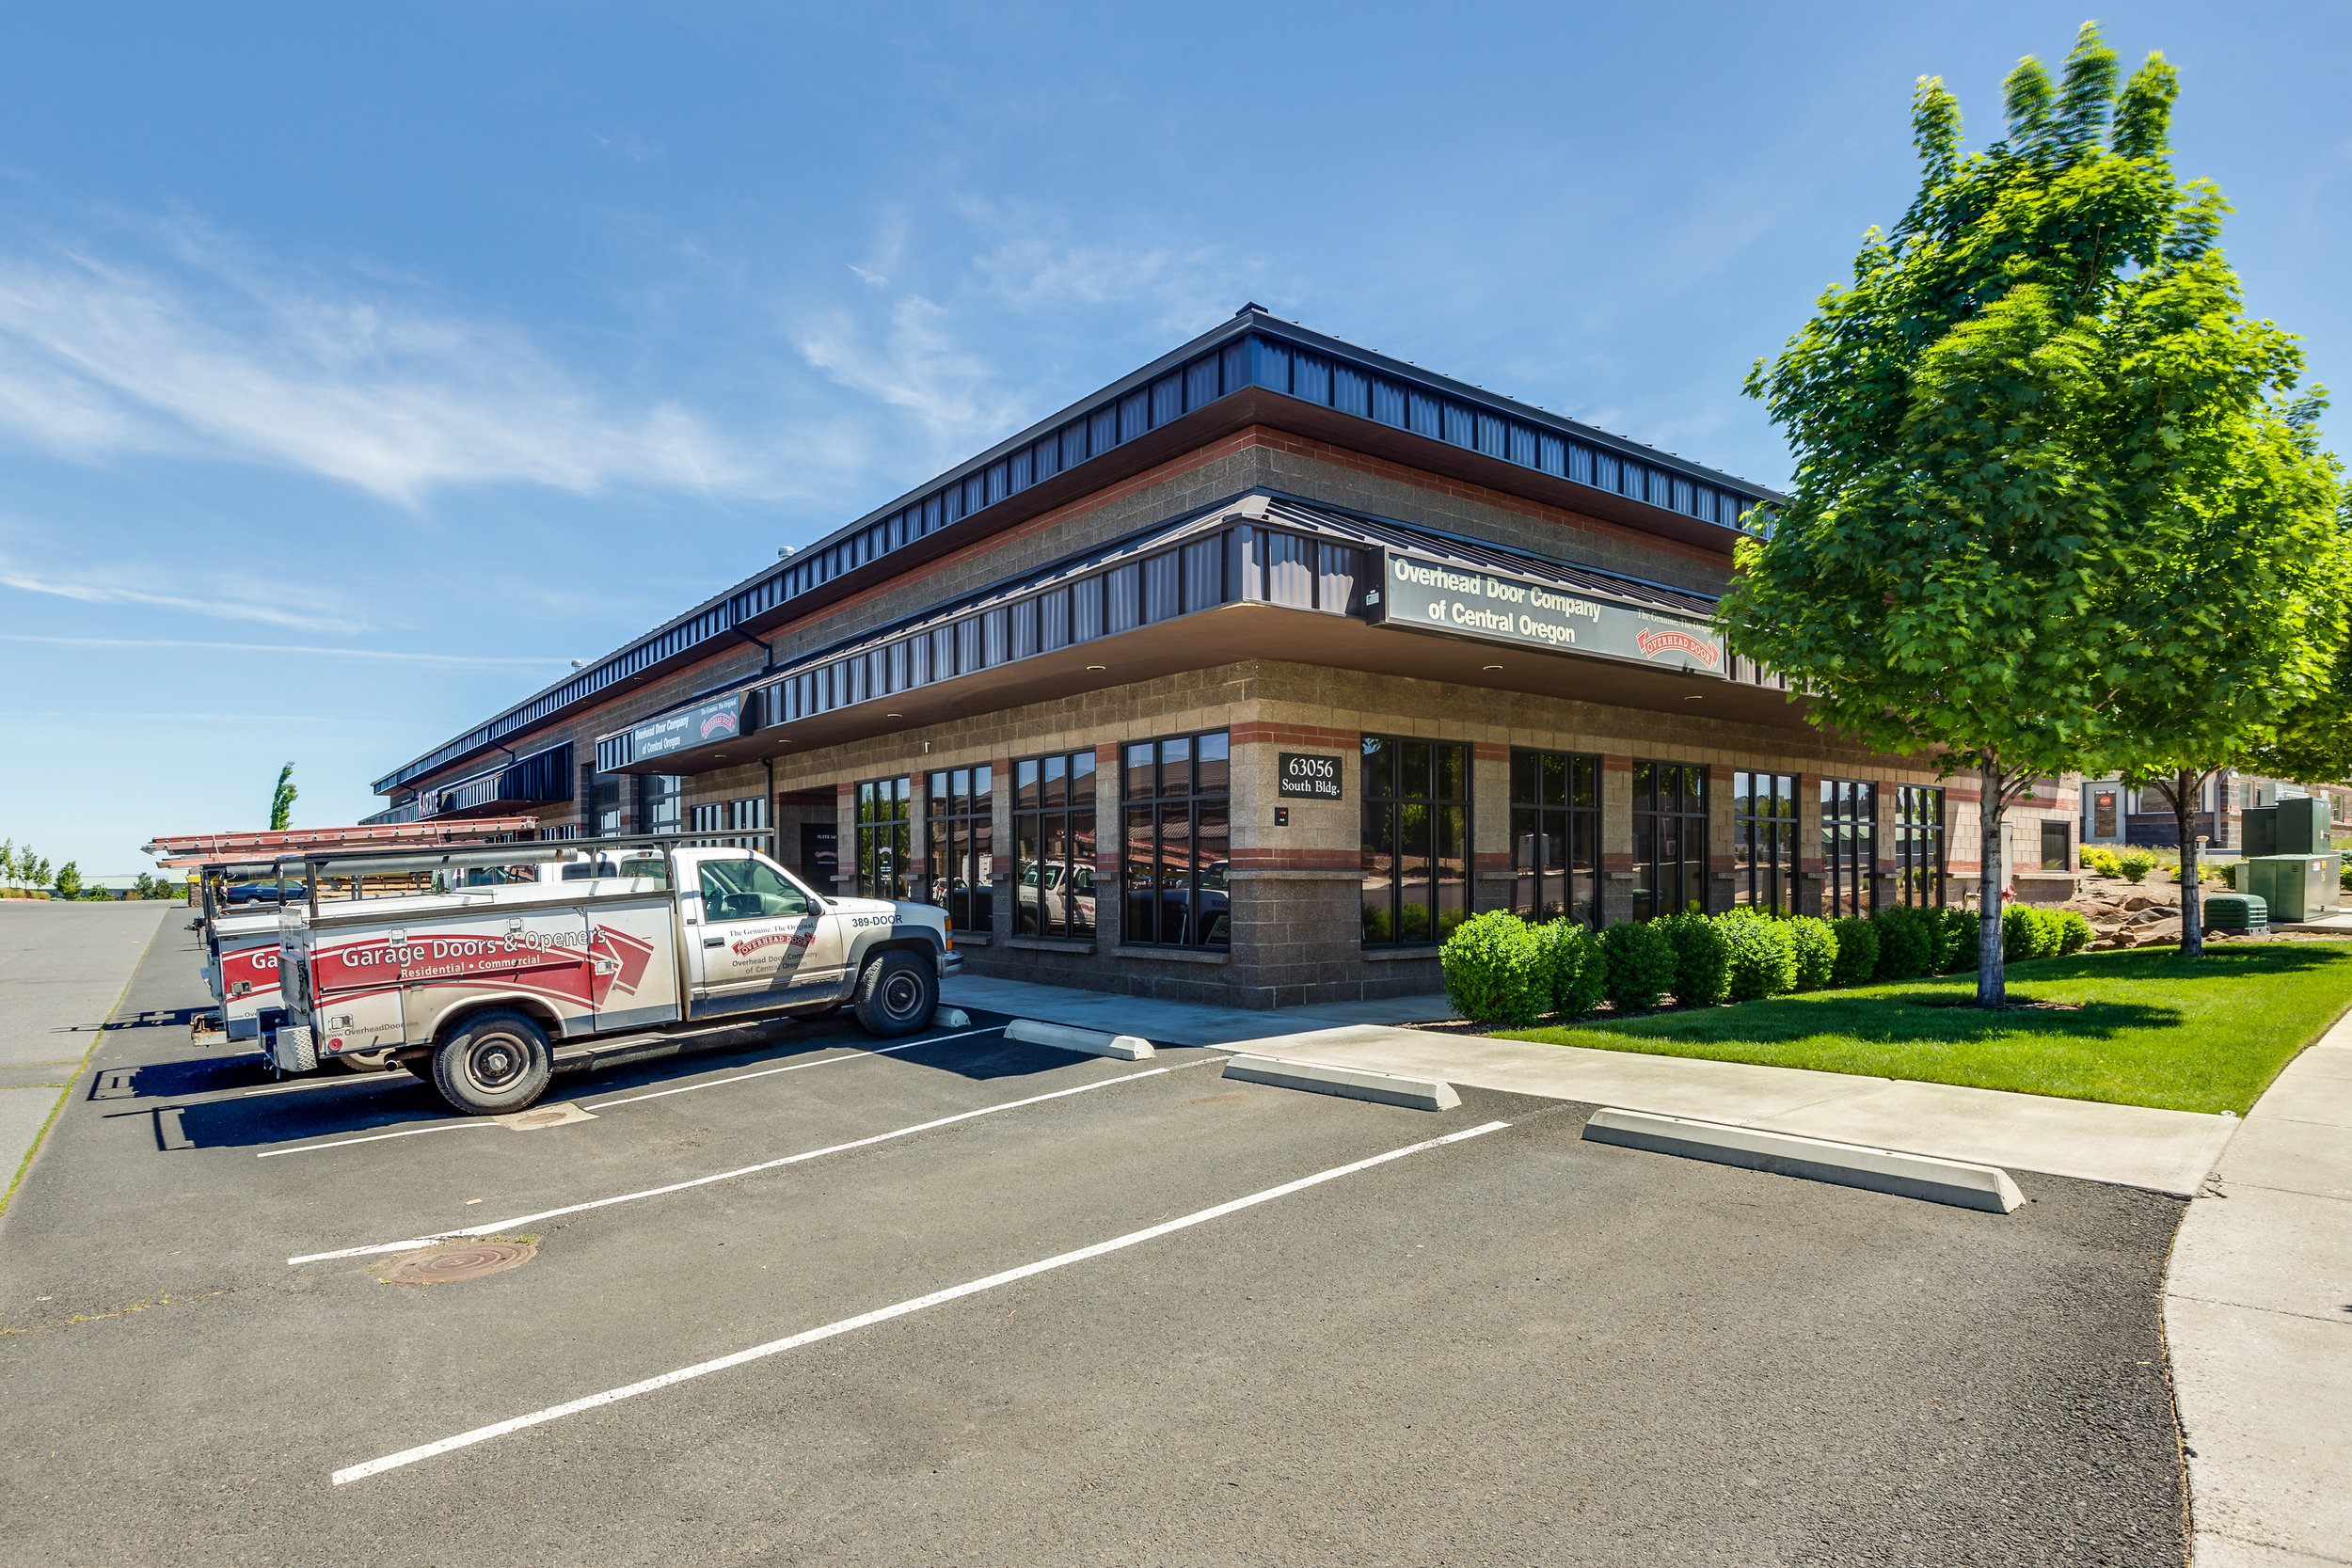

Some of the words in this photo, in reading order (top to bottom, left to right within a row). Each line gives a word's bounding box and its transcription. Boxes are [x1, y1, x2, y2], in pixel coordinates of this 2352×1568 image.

[1394, 559, 1481, 594] Overhead
[1486, 578, 1525, 603] Door
[1530, 586, 1601, 623] Company
[1428, 600, 1446, 621] of
[1452, 602, 1514, 632] Central
[1518, 615, 1576, 644] Oregon
[1637, 609, 1650, 620] The
[1680, 618, 1692, 629] The
[1646, 636, 1689, 652] OVERHEAD
[1691, 642, 1710, 663] DOOR
[635, 725, 655, 740] Overhead
[655, 723, 666, 735] Door
[667, 716, 690, 731] Company
[704, 716, 723, 734] OVERHEAD
[723, 716, 733, 728] DOOR
[642, 743, 646, 754] of
[647, 738, 663, 753] Central
[663, 736, 681, 750] Oregon
[1289, 757, 1333, 778] 63056
[1281, 778, 1311, 792] South
[1315, 780, 1340, 796] Bldg.
[851, 914, 903, 927] 389-DOOR
[342, 945, 425, 968] Garage
[432, 938, 498, 958] Doors
[502, 932, 519, 952] &
[524, 927, 607, 954] Openers
[741, 936, 785, 954] OVERHEAD
[786, 936, 807, 946] DOOR
[400, 961, 465, 979] Residential
[478, 955, 541, 970] Commercial
[732, 957, 766, 968] Overhead
[768, 954, 785, 963] Door
[787, 952, 818, 961] Company
[745, 966, 753, 974] of
[755, 963, 781, 974] Central
[782, 961, 807, 971] Oregon
